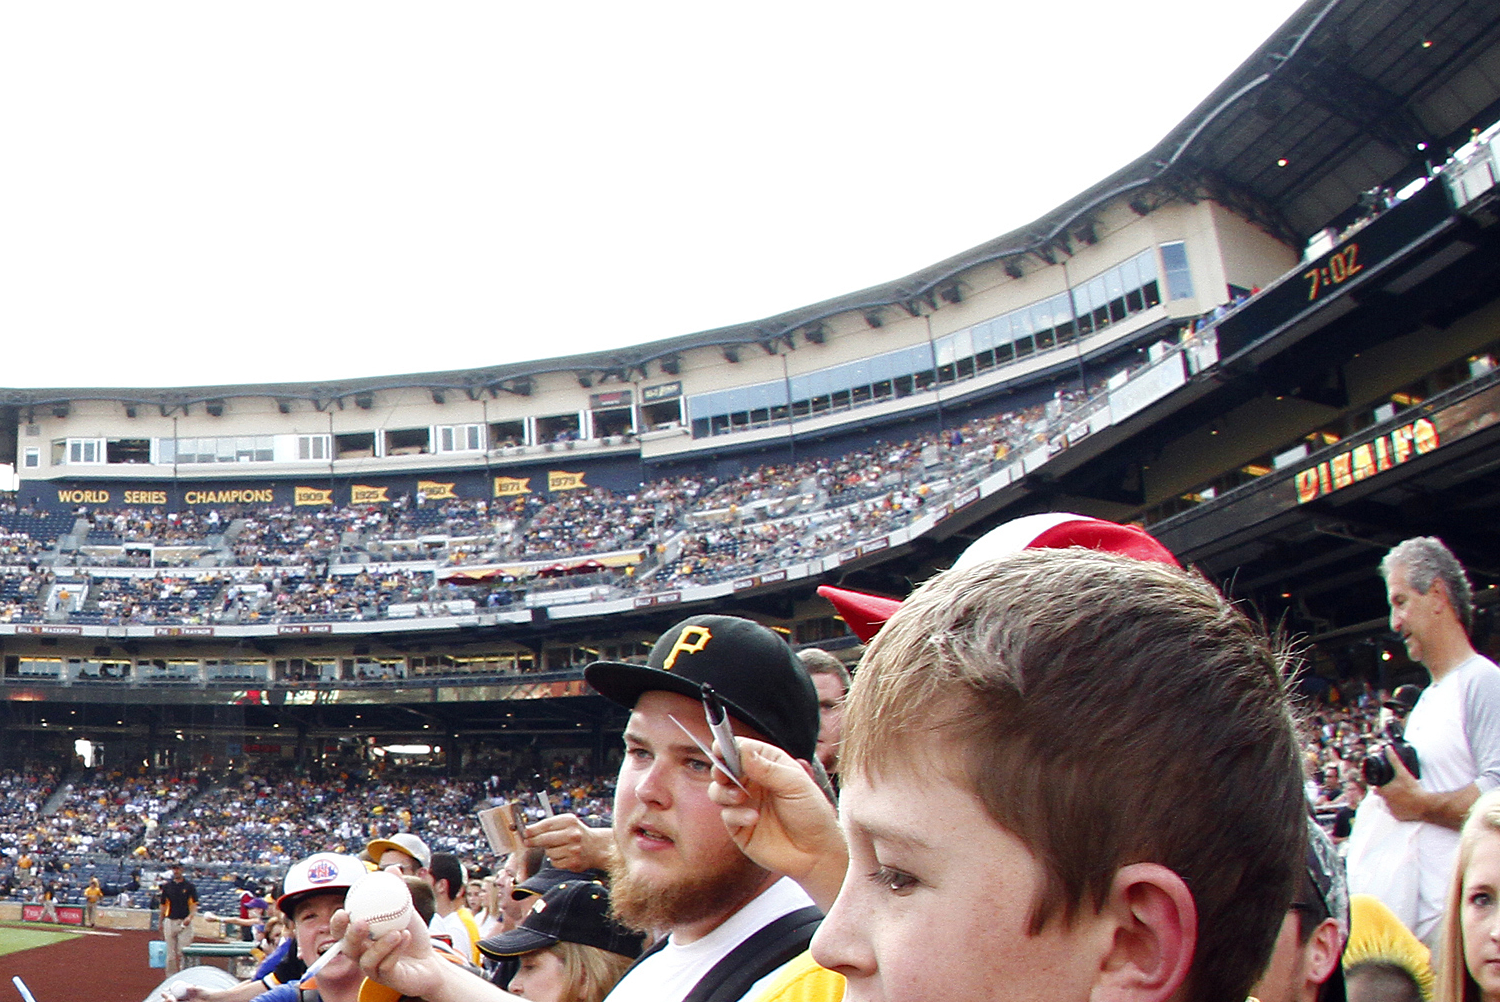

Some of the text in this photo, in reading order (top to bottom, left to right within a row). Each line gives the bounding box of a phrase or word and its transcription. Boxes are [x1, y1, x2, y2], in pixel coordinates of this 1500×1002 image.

[1303, 243, 1364, 300] 7:02
[58, 489, 274, 504] WORLD SERIES CHAMPIONS
[663, 625, 713, 671] P
